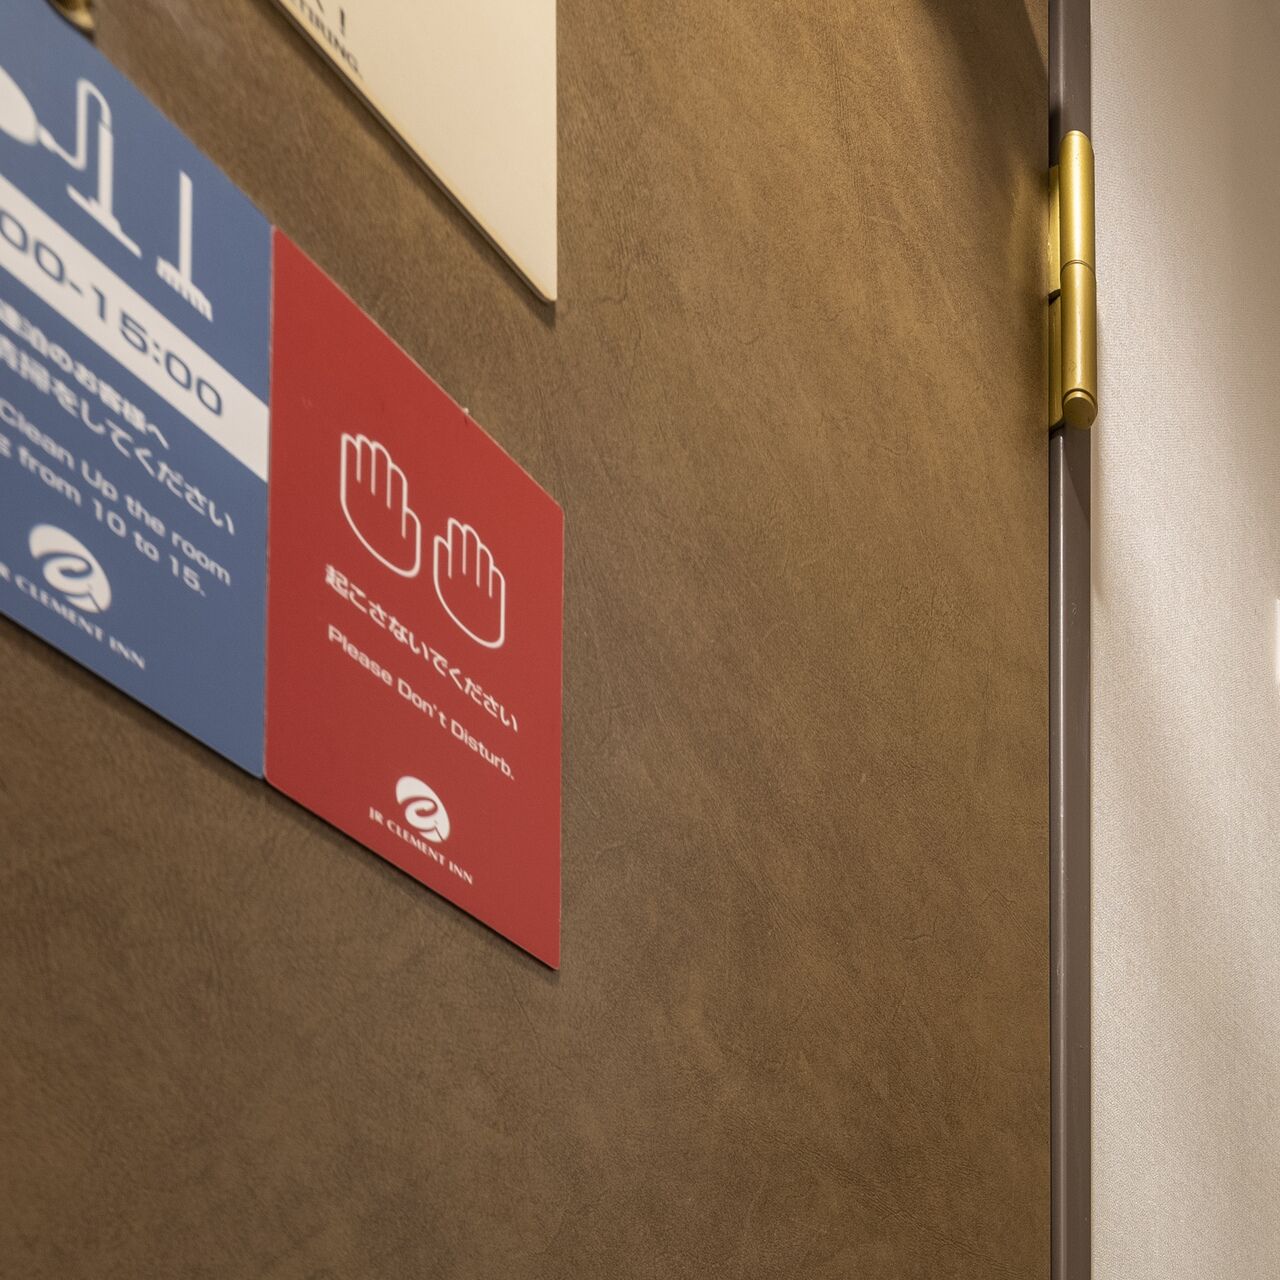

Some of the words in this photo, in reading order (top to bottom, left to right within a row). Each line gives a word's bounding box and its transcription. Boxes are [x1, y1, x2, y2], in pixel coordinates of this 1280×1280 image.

[0, 397, 75, 471] Clean
[81, 458, 118, 502] Up
[124, 493, 165, 537] the
[171, 530, 232, 587] room
[18, 445, 82, 508] from
[92, 497, 127, 538] 10
[133, 530, 159, 563] to
[14, 574, 104, 642] CLEMENT
[109, 635, 146, 671] INN
[325, 563, 519, 733] 起こさないでください
[328, 623, 393, 687] Please
[398, 677, 447, 729] Don't
[451, 718, 516, 781] Disturb.
[368, 806, 384, 825] JR
[386, 819, 445, 866] CLEMENT
[448, 860, 473, 885] INN
